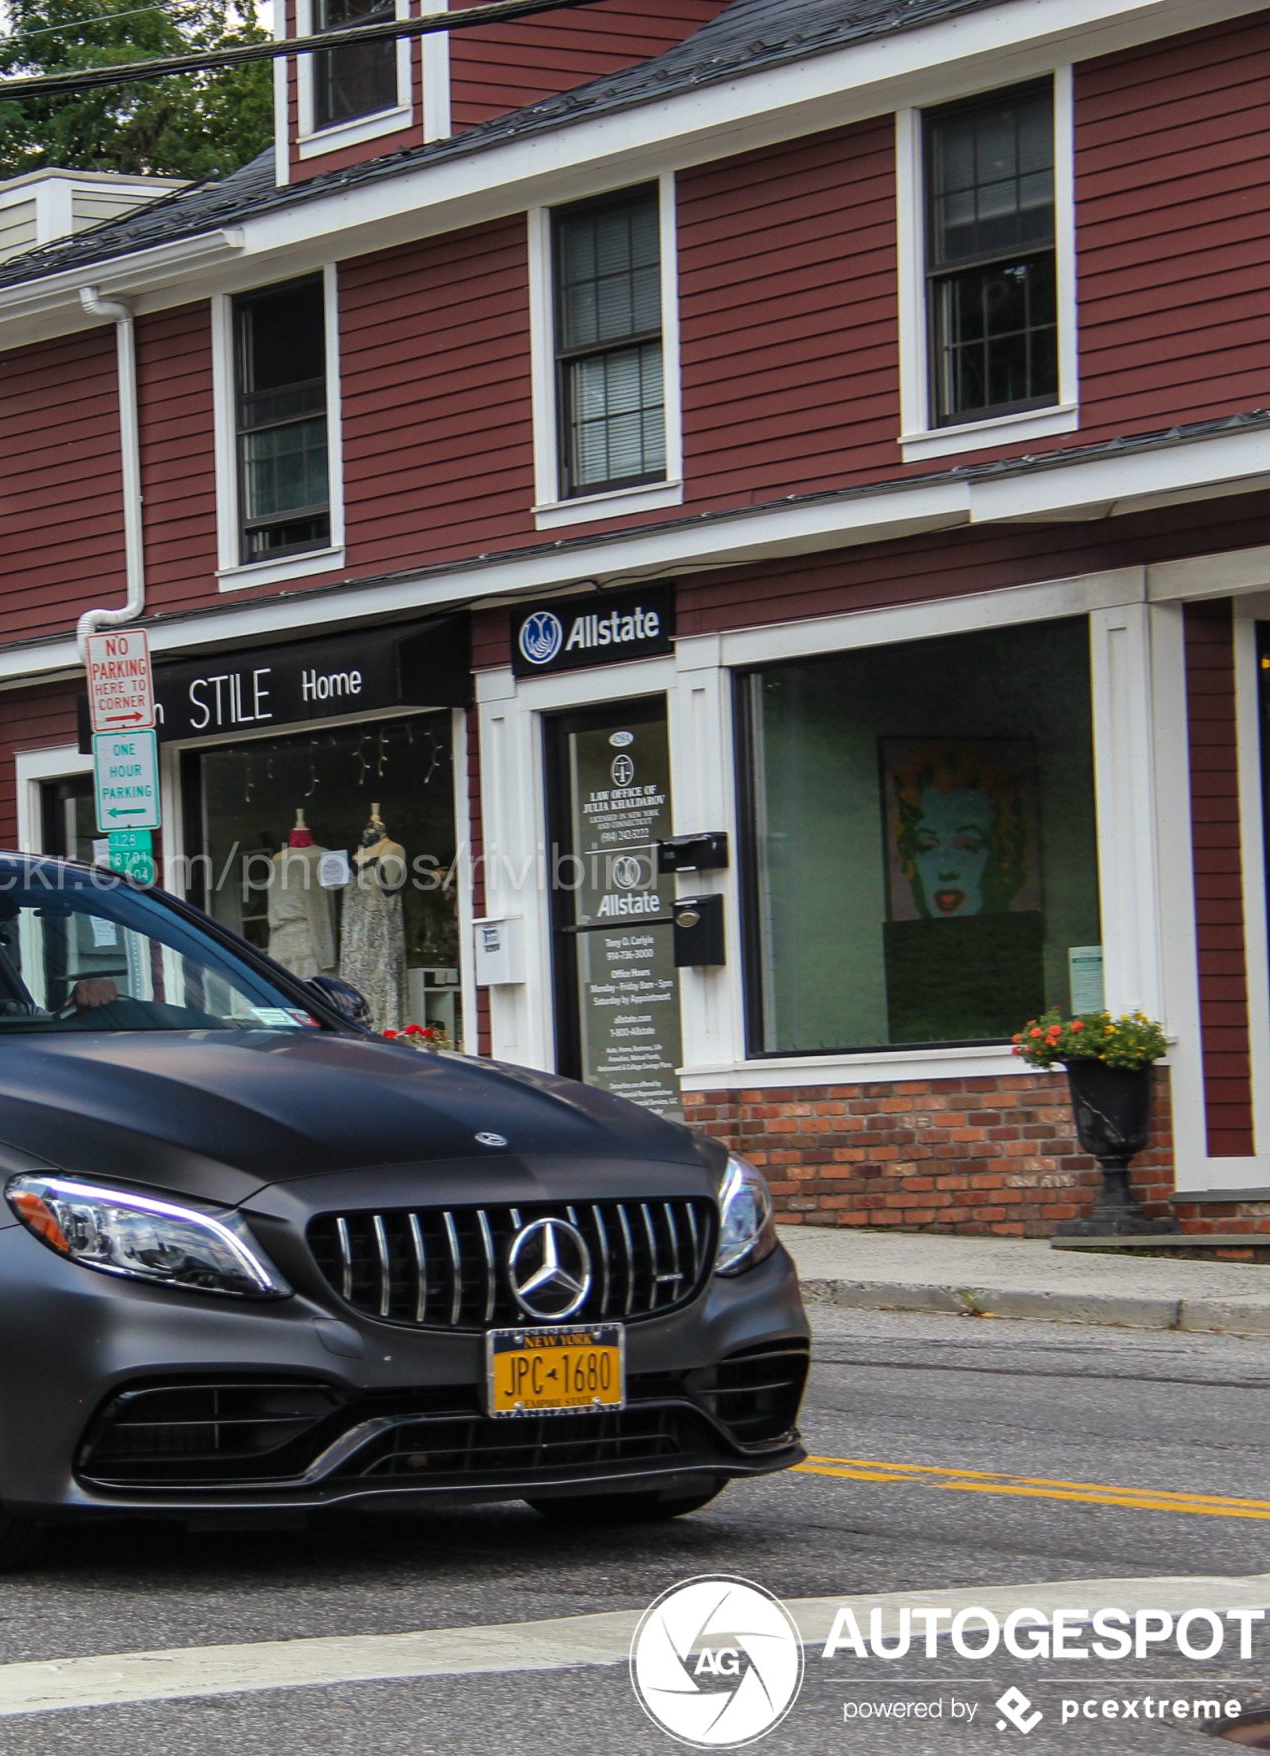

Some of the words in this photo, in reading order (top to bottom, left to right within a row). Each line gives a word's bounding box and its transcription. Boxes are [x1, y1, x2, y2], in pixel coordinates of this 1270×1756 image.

[565, 606, 660, 651] Allstate
[105, 637, 129, 657] NO
[92, 658, 147, 680] PARKING
[95, 681, 125, 695] HERE
[131, 679, 147, 692] TO
[99, 694, 146, 711] CORNER
[188, 667, 273, 730] STILE
[301, 668, 362, 702] Home
[113, 743, 136, 756] ONE
[109, 764, 142, 778] HOUR
[102, 784, 152, 800] PARKING
[589, 791, 610, 802] LAW
[610, 787, 643, 799] OFFICE
[643, 785, 657, 795] OF
[582, 801, 610, 813] JULIA
[115, 834, 136, 846] 128
[115, 851, 147, 866] 8701
[596, 891, 661, 917] Allstate
[604, 938, 622, 949] Tony
[610, 969, 631, 979] Office
[631, 968, 651, 977] Hours
[590, 984, 616, 994] Monday
[620, 982, 639, 992] Friday
[593, 996, 621, 1006] Saturday
[621, 995, 630, 1005] by
[630, 992, 671, 1004] Appointment
[524, 1335, 558, 1348] NEW
[560, 1333, 593, 1346] YORK
[503, 1355, 543, 1396] JPC
[562, 1350, 611, 1393] 1680
[524, 1398, 561, 1409] EMPIRE
[565, 1395, 593, 1407] STATE
[495, 1403, 621, 1418] MANHATTAN
